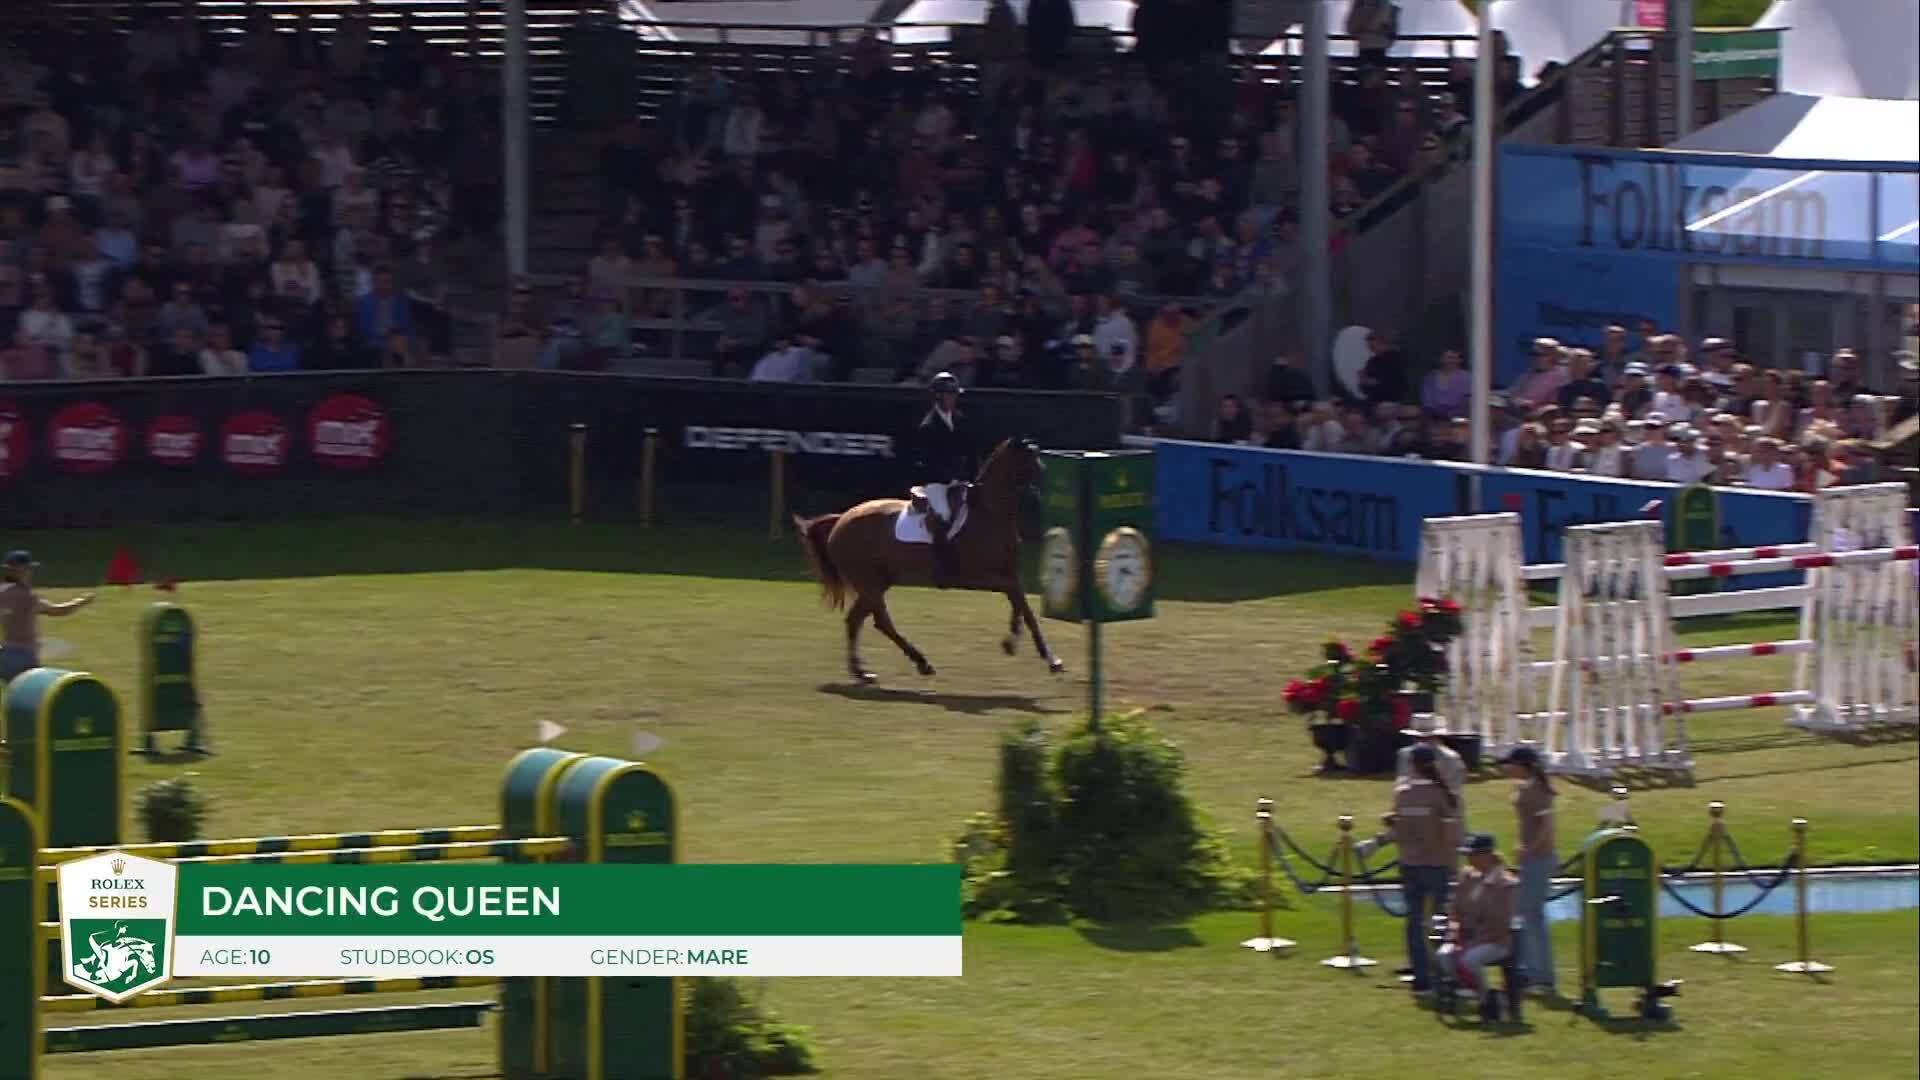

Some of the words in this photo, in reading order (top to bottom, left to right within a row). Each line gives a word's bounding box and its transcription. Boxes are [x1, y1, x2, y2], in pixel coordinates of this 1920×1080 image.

[1573, 153, 1827, 259] Folksam
[686, 426, 895, 458] DEFENDER
[1208, 458, 1399, 551] Folksam
